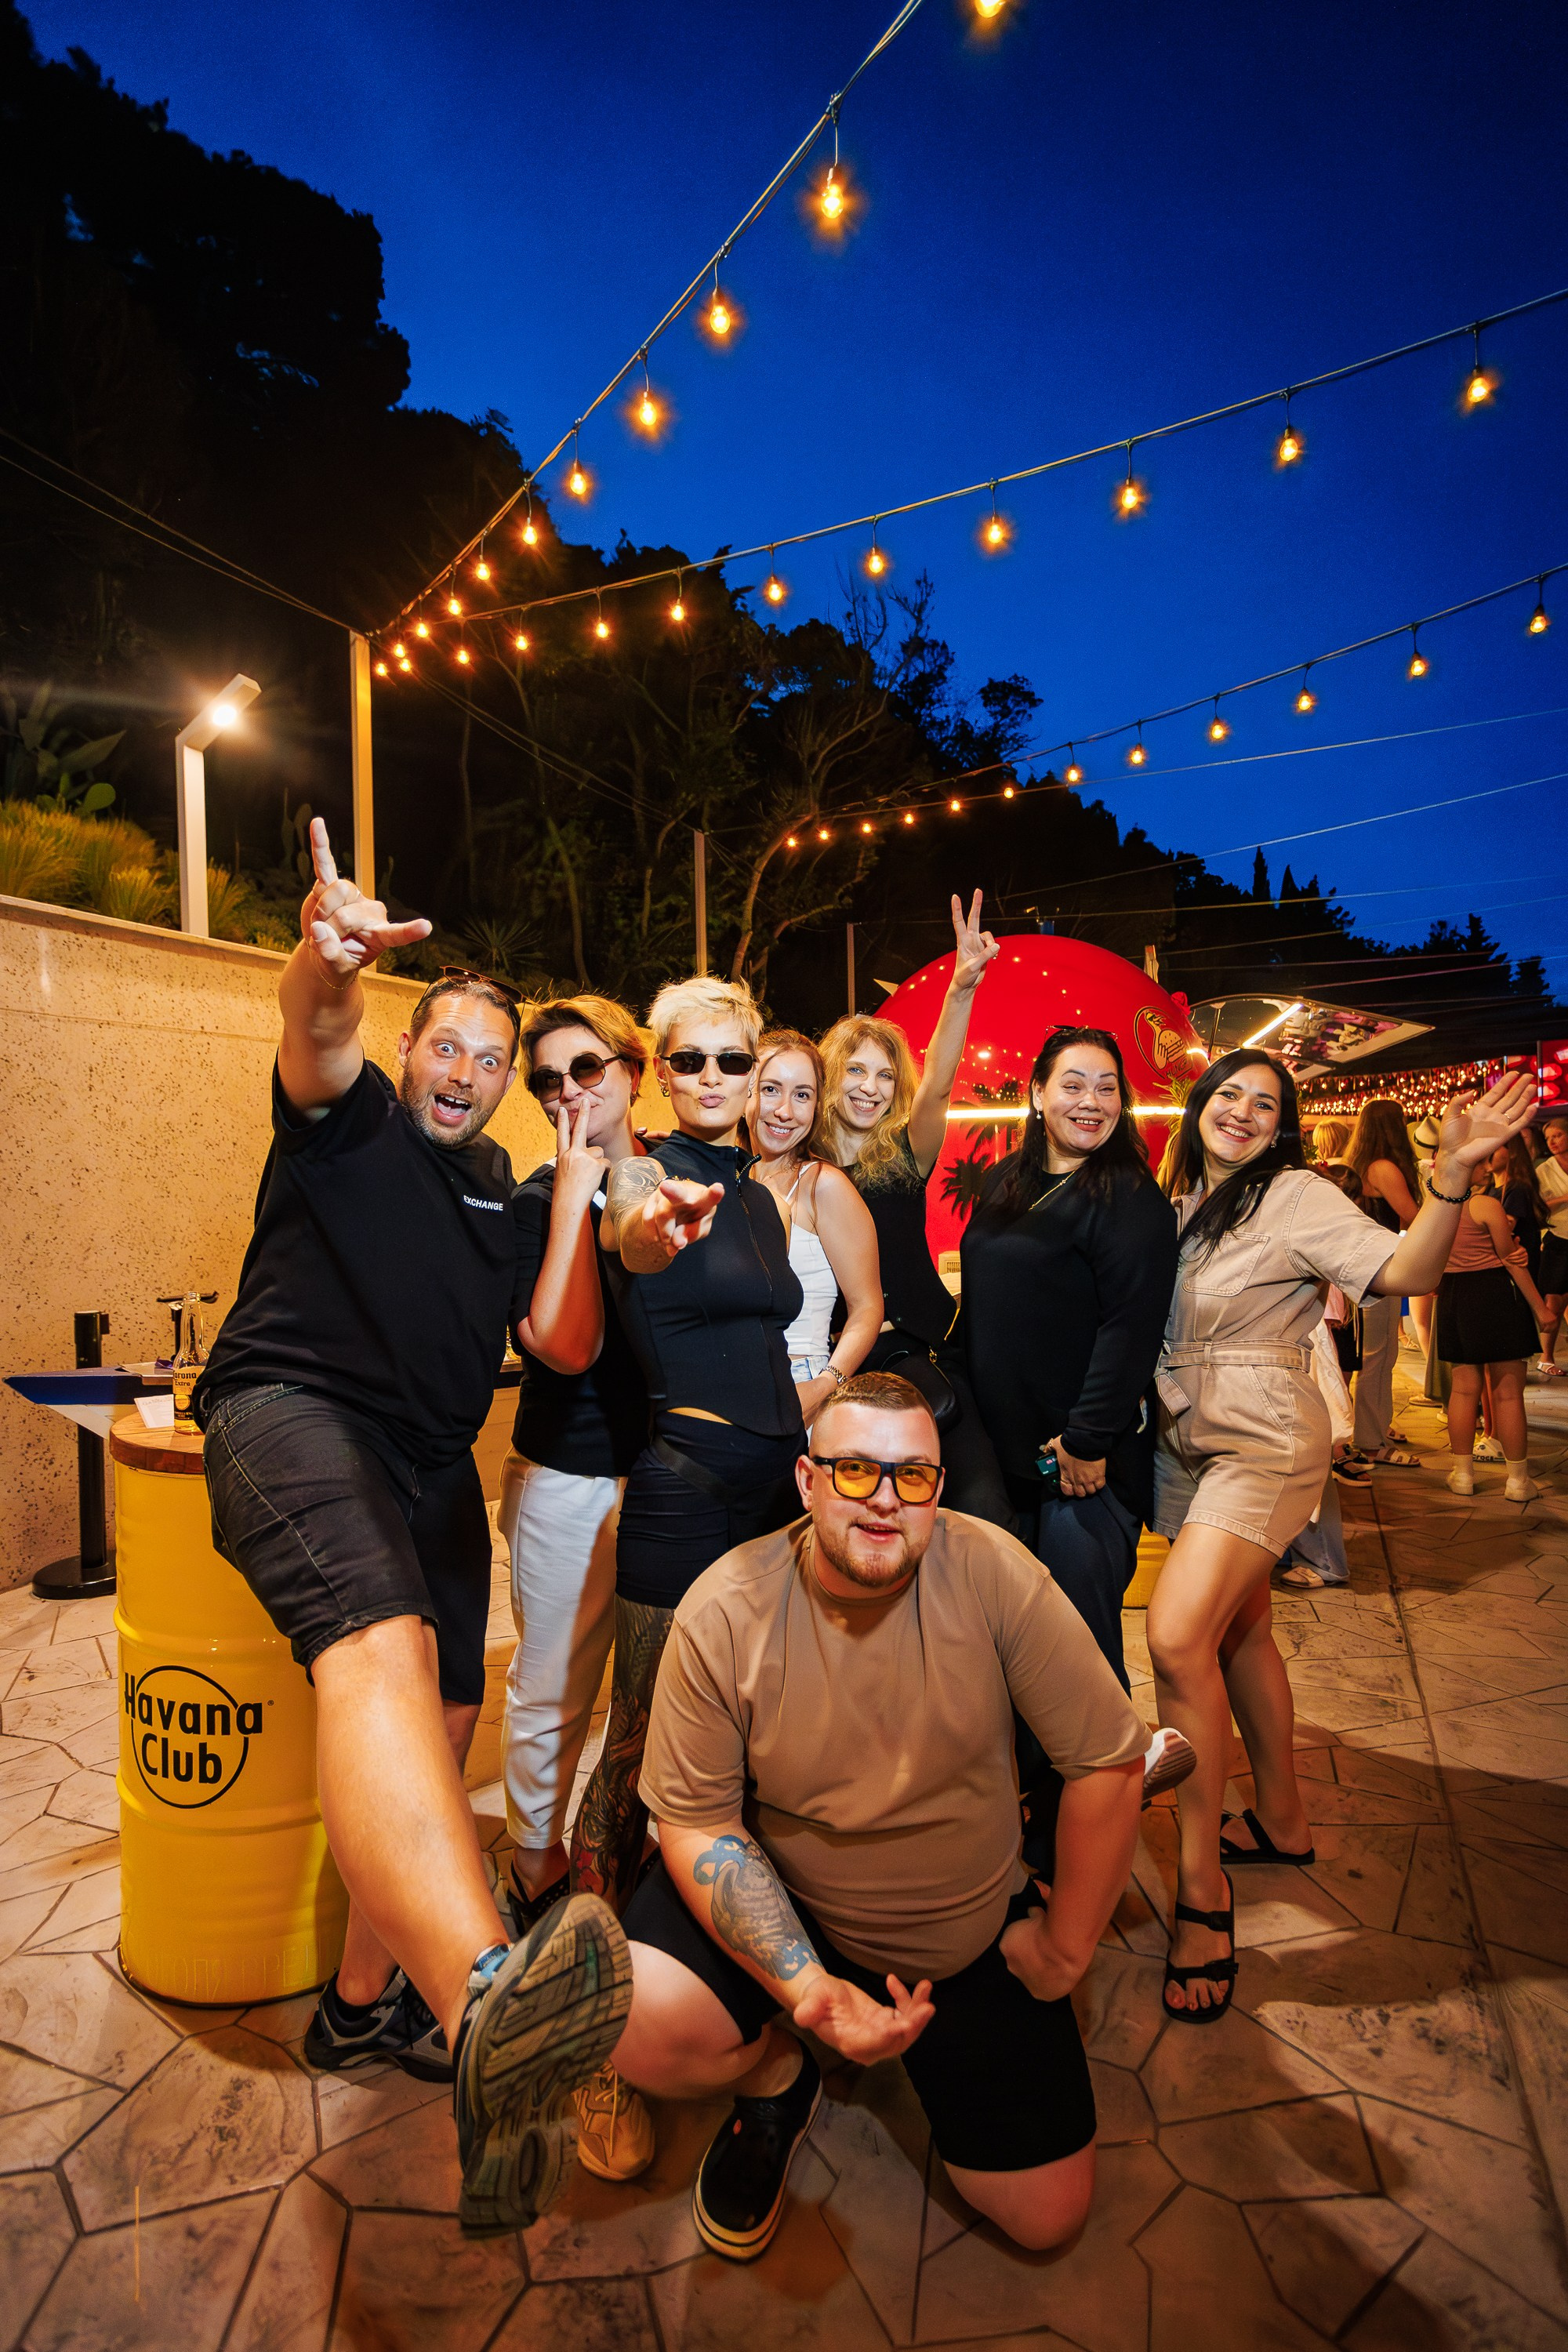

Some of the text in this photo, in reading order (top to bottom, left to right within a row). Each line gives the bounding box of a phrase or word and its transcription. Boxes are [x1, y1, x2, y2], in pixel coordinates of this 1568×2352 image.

[463, 1195, 503, 1211] EXCHANGE
[125, 1672, 263, 1736] Havana
[142, 1733, 222, 1784] Club
